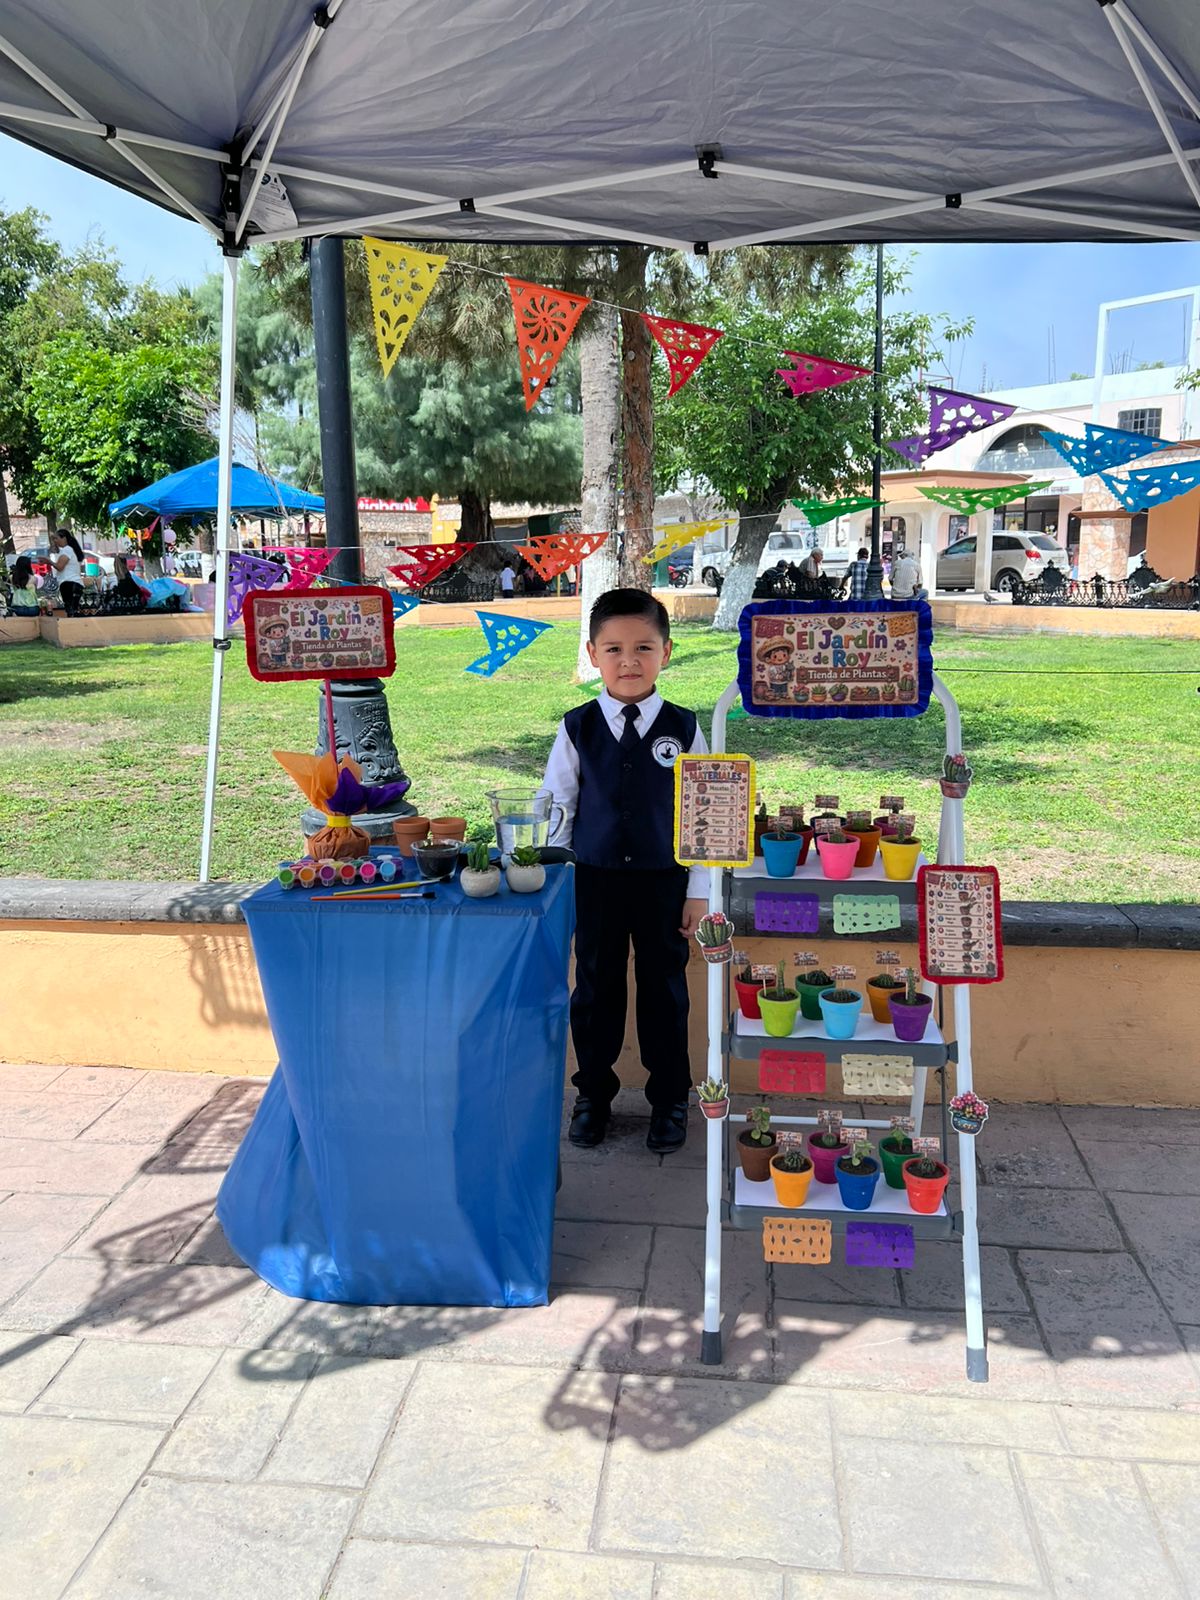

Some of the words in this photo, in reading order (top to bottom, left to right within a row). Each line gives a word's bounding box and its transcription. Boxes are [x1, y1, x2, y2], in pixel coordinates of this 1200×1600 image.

[290, 610, 305, 627] El
[308, 609, 362, 626] Jardín
[304, 628, 318, 639] de
[320, 626, 350, 641] Roy
[797, 631, 815, 650] El
[818, 630, 888, 650] Jardín
[302, 642, 325, 651] Tienda
[326, 642, 335, 650] de
[336, 641, 362, 650] Plantas
[813, 652, 829, 665] de
[833, 650, 871, 669] Roy
[808, 670, 838, 680] Tienda
[839, 669, 851, 679] de
[853, 669, 887, 679] Plantas
[690, 771, 742, 781] MATERIALES
[940, 882, 980, 891] PROCESO
